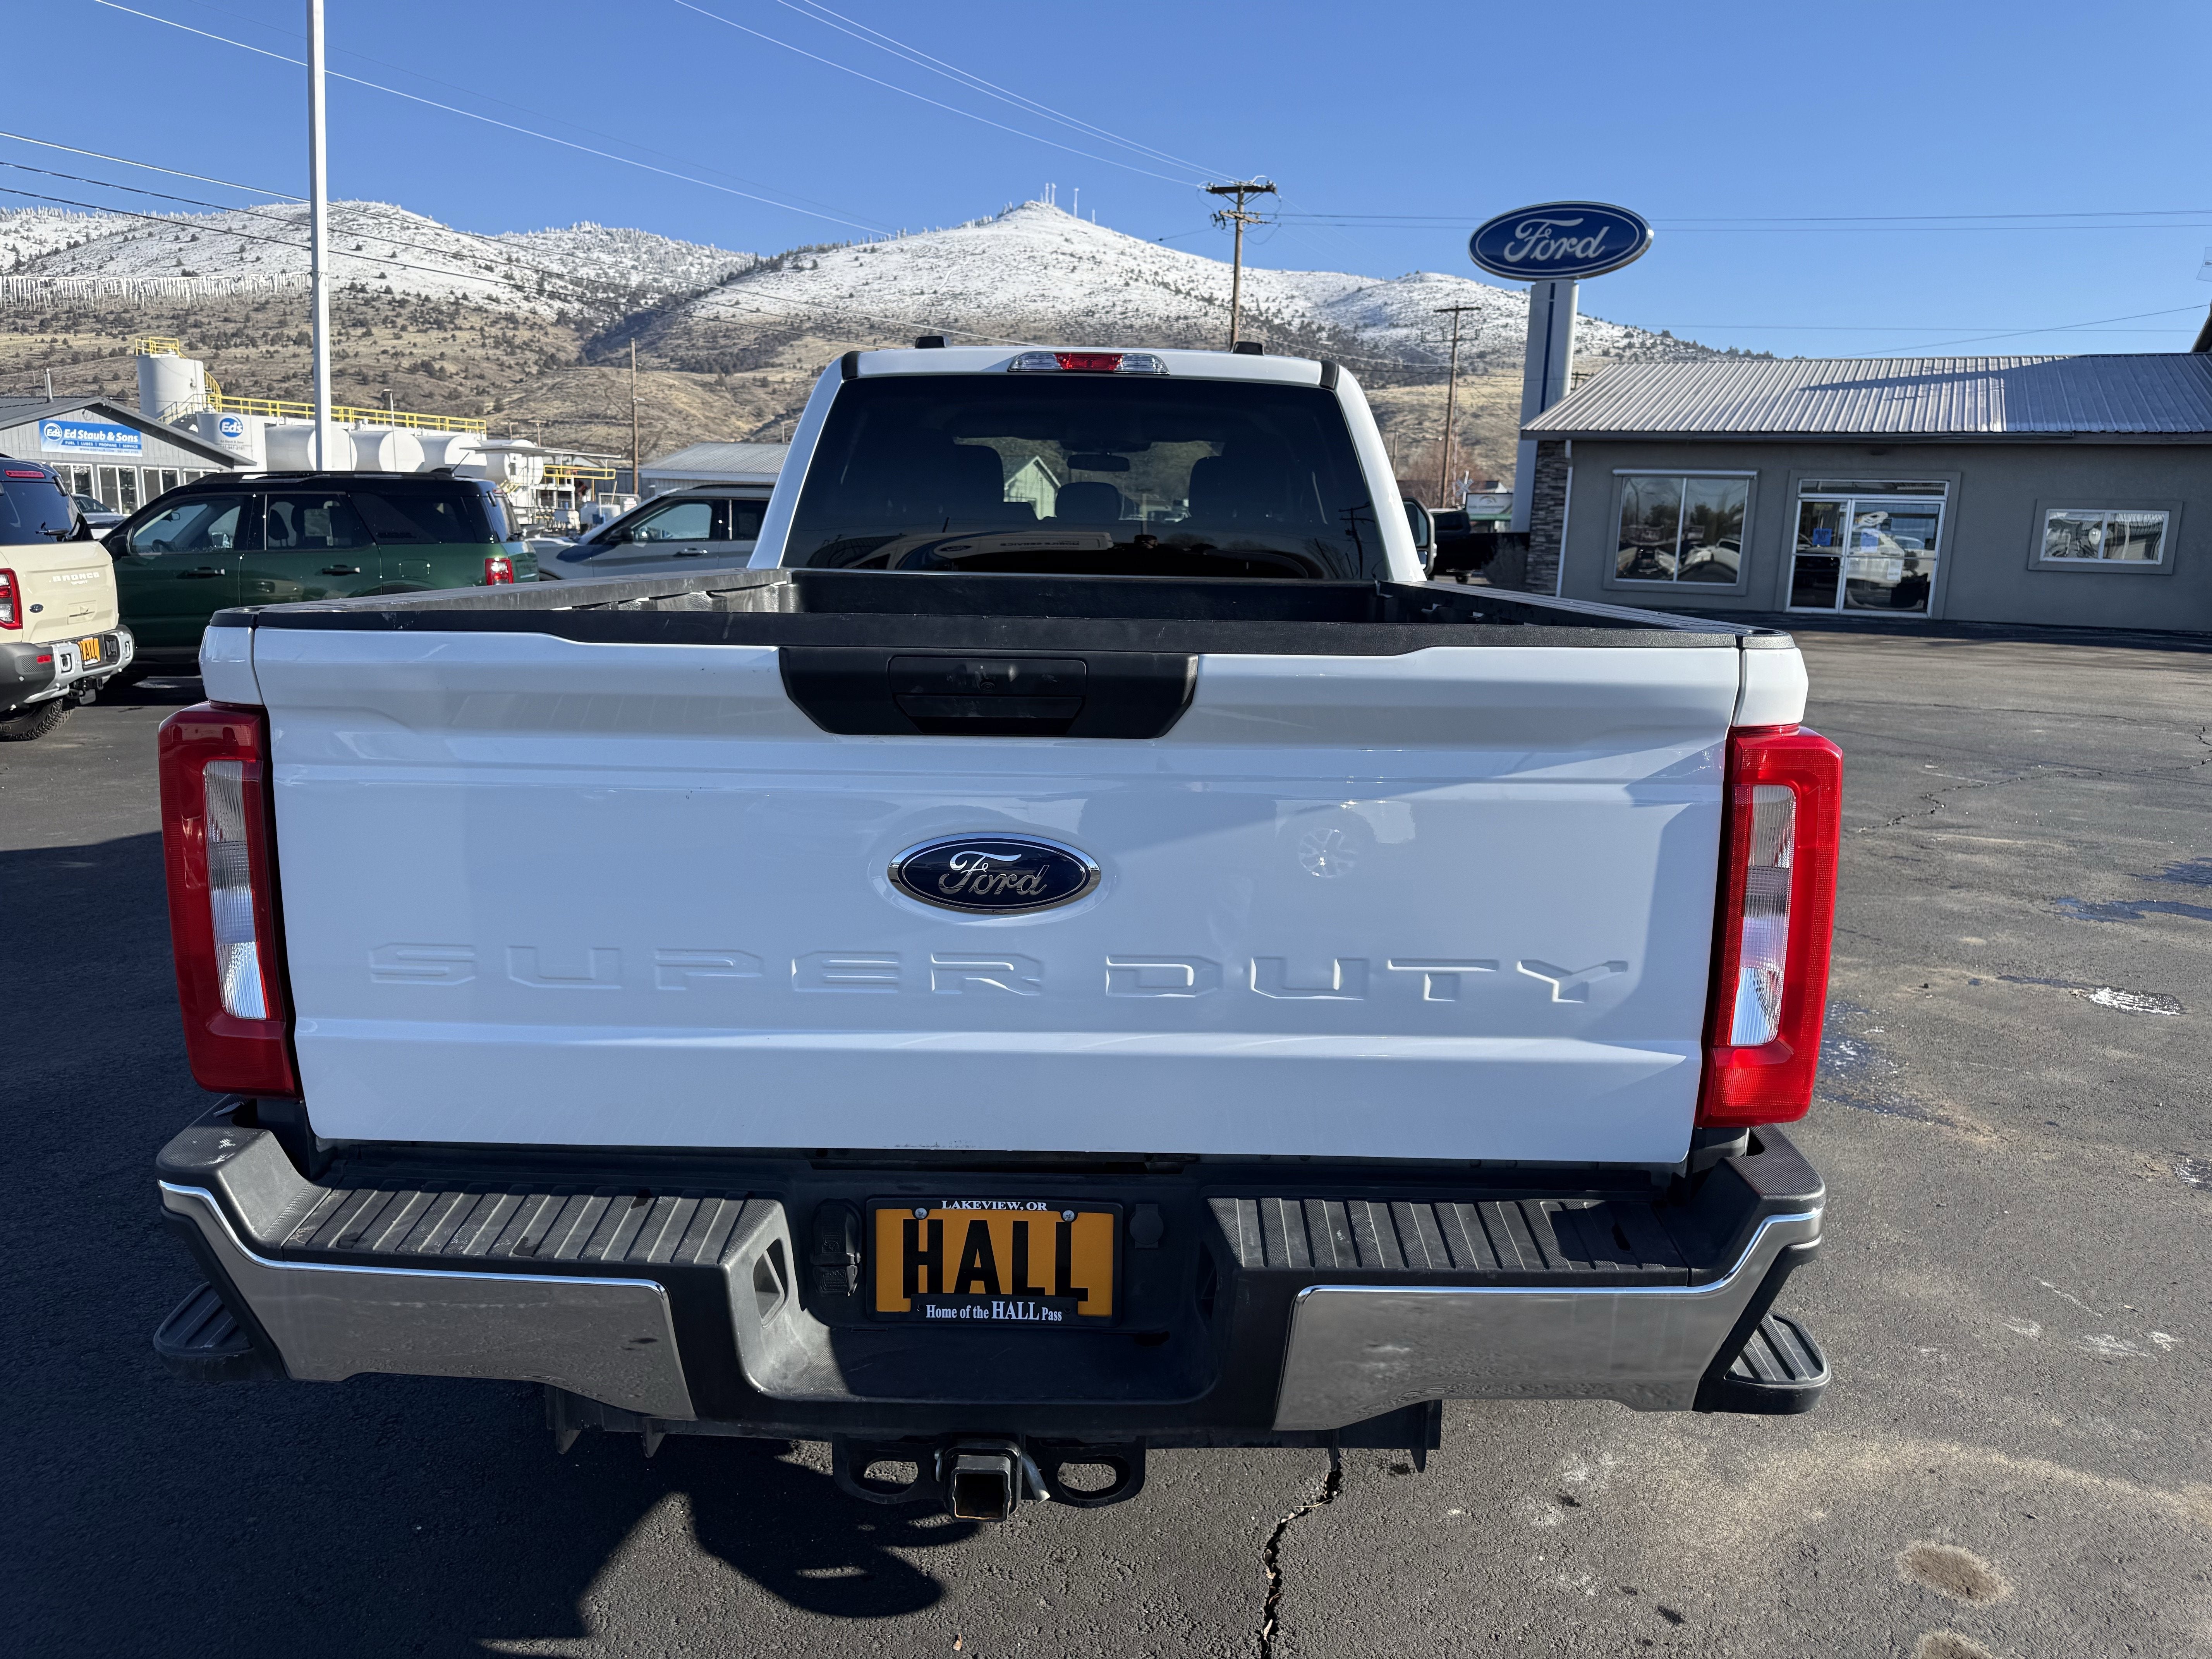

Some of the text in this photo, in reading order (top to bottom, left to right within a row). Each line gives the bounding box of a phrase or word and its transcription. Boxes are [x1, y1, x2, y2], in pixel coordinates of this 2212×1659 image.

[1503, 218, 1610, 263] Ford
[64, 429, 138, 443] Ed Staub & Sons
[52, 572, 100, 582] BRONCO
[938, 851, 1049, 895] Ford
[367, 943, 1628, 1003] SUPER DUTY
[941, 1200, 1048, 1211] LAKEVIEW, OR
[903, 1218, 1089, 1302] HALL
[926, 1301, 1062, 1321] Home of the HALL Pass
